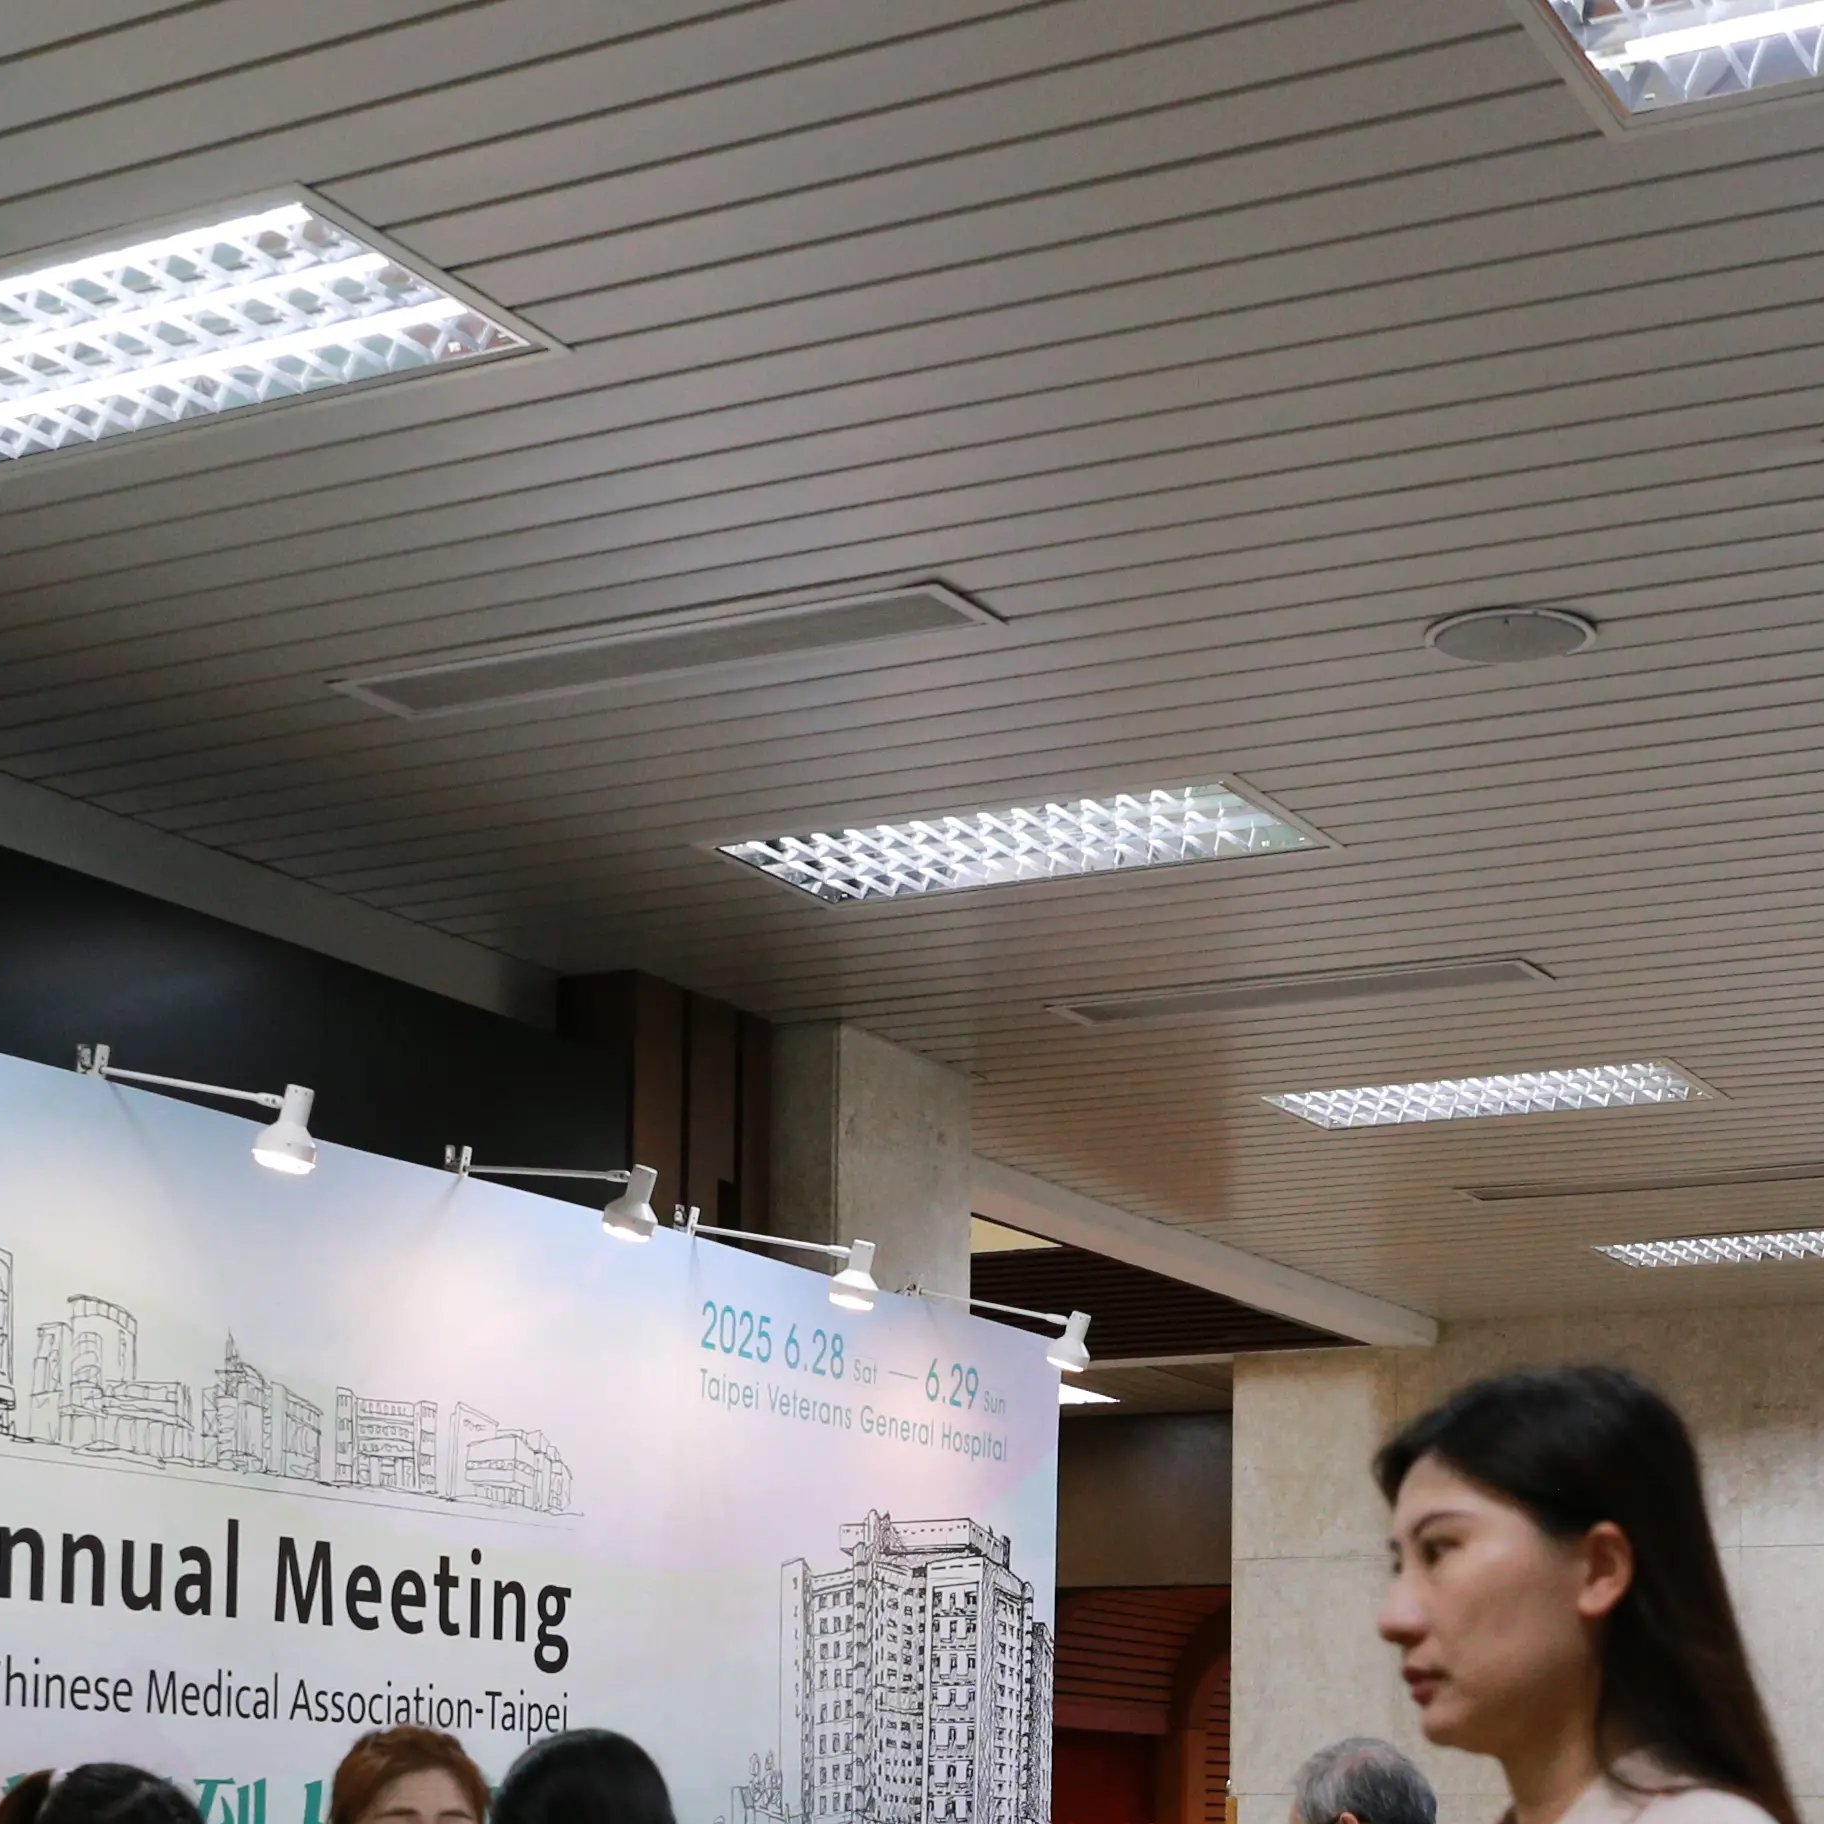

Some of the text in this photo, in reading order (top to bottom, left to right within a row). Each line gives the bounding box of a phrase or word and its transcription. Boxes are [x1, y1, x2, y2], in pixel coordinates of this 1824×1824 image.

[700, 1300, 773, 1364] 2025
[784, 1323, 845, 1380] 6.28
[853, 1358, 878, 1385] Sat
[925, 1358, 980, 1410] 6.29
[984, 1390, 1007, 1415] Sun
[700, 1367, 1008, 1462] Taipei Veterans General Hospital
[274, 1536, 573, 1674] Meeting
[146, 1669, 280, 1720] Medical
[290, 1677, 569, 1743] Association-Taipei
